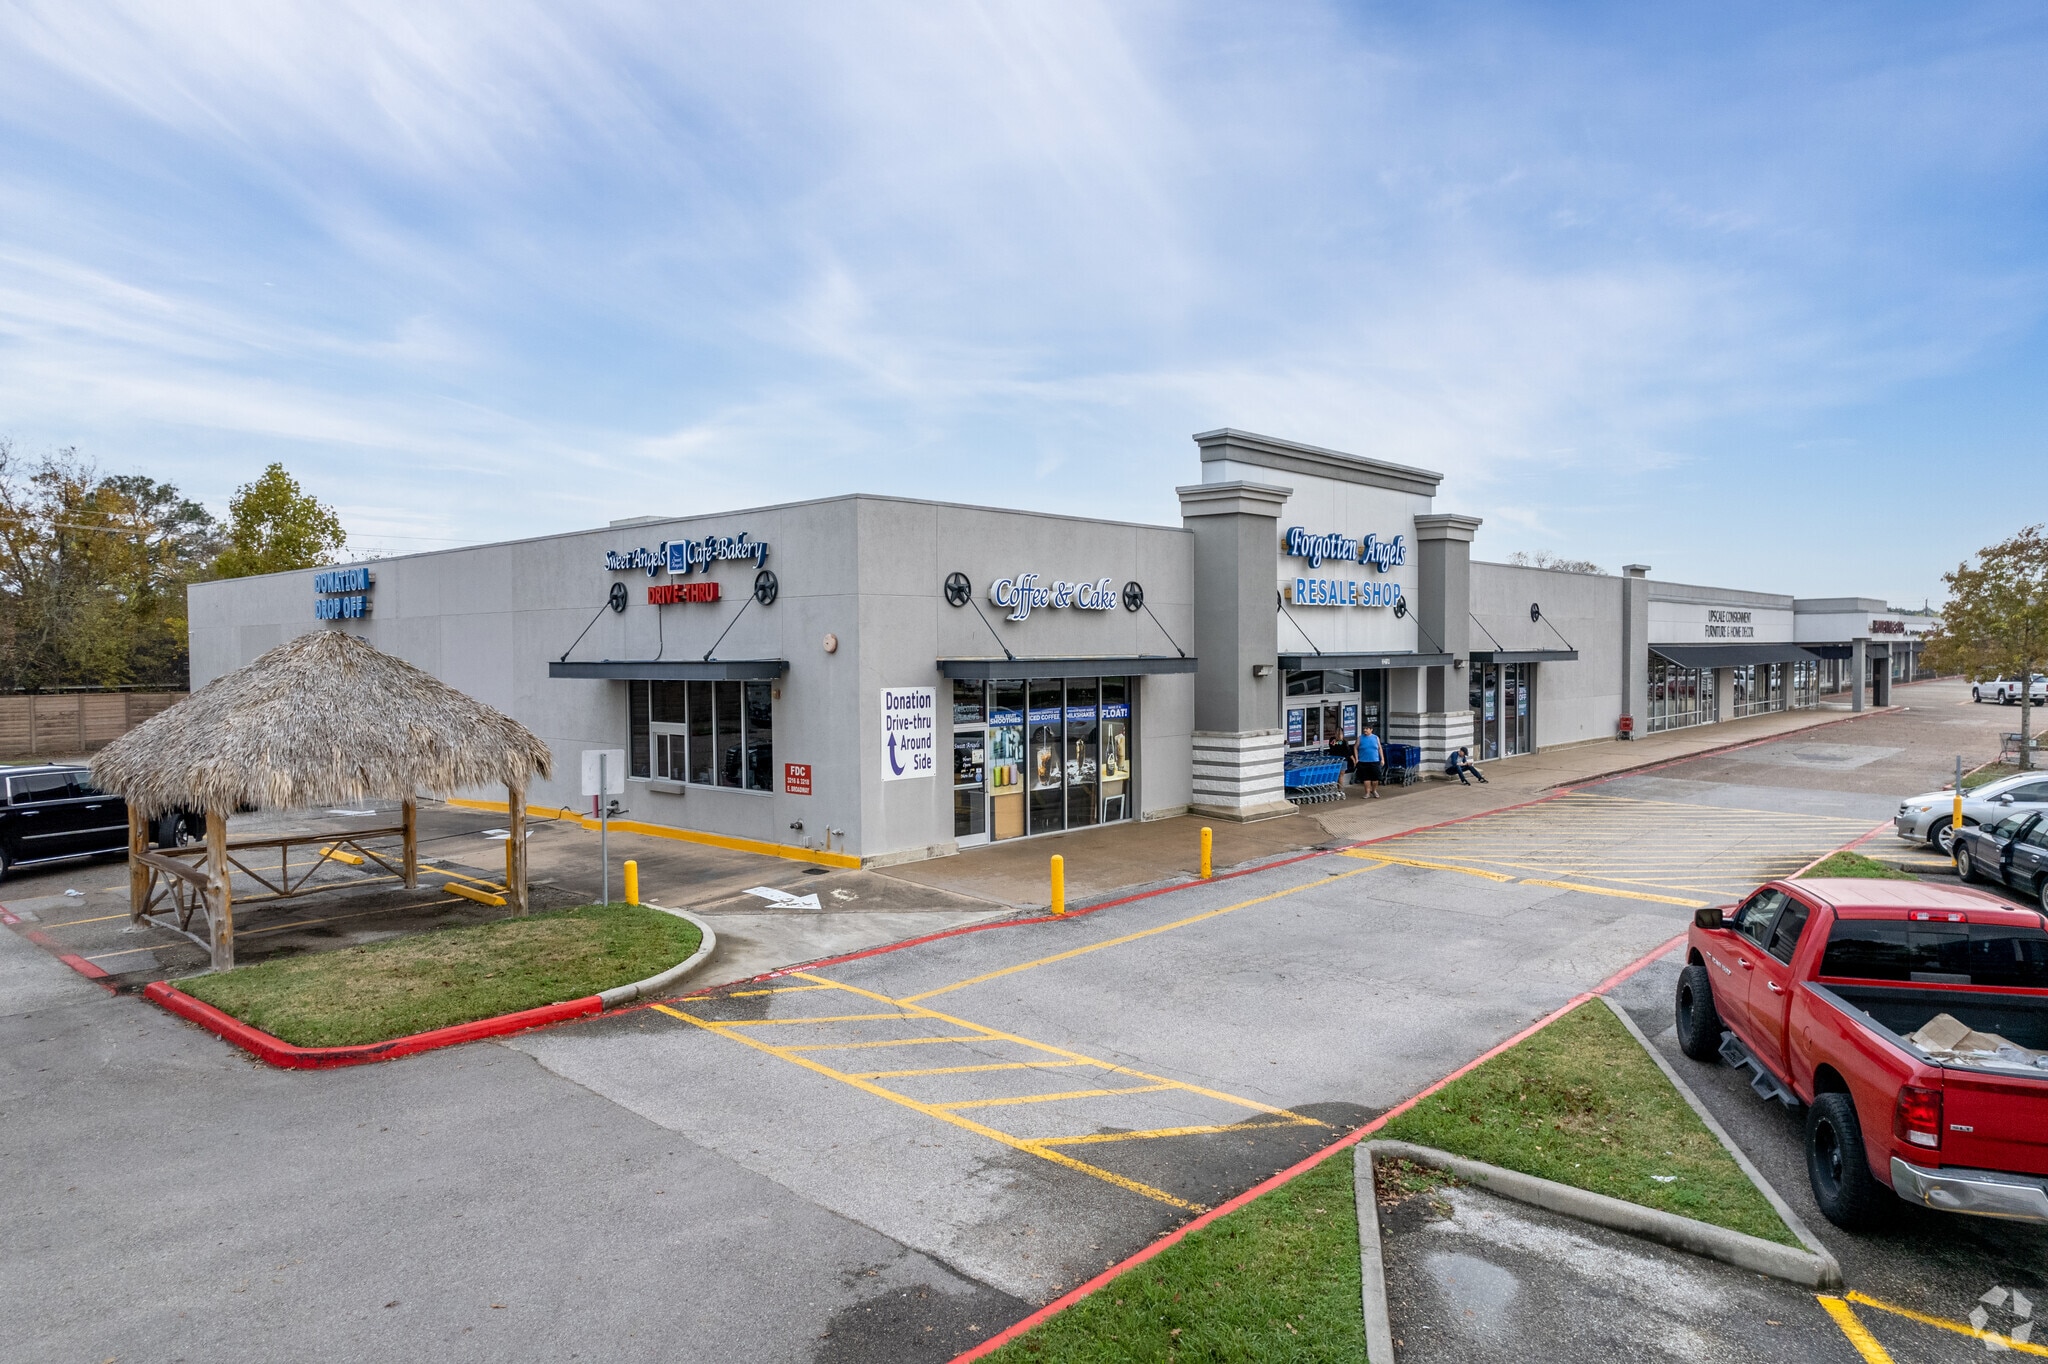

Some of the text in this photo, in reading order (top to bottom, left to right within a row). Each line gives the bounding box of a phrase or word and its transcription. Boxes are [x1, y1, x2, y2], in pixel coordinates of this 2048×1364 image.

[604, 550, 631, 571] Sweet
[631, 542, 666, 577] Angels
[1288, 527, 1407, 573] Forgotten Angels
[314, 569, 366, 594] DONATION
[648, 582, 714, 604] DRIVE-THRU
[995, 573, 1118, 620] Coffee & Cake
[1295, 577, 1402, 608] RESALE SHOP
[314, 596, 363, 620] DROP OFF
[885, 690, 931, 711] Donation
[886, 712, 931, 731] Drive-thru
[990, 717, 1021, 725] SMOOTHIES
[1101, 708, 1128, 718] FLOAT!
[900, 732, 931, 751] Around
[790, 765, 806, 777] FDC
[913, 753, 932, 770] Side
